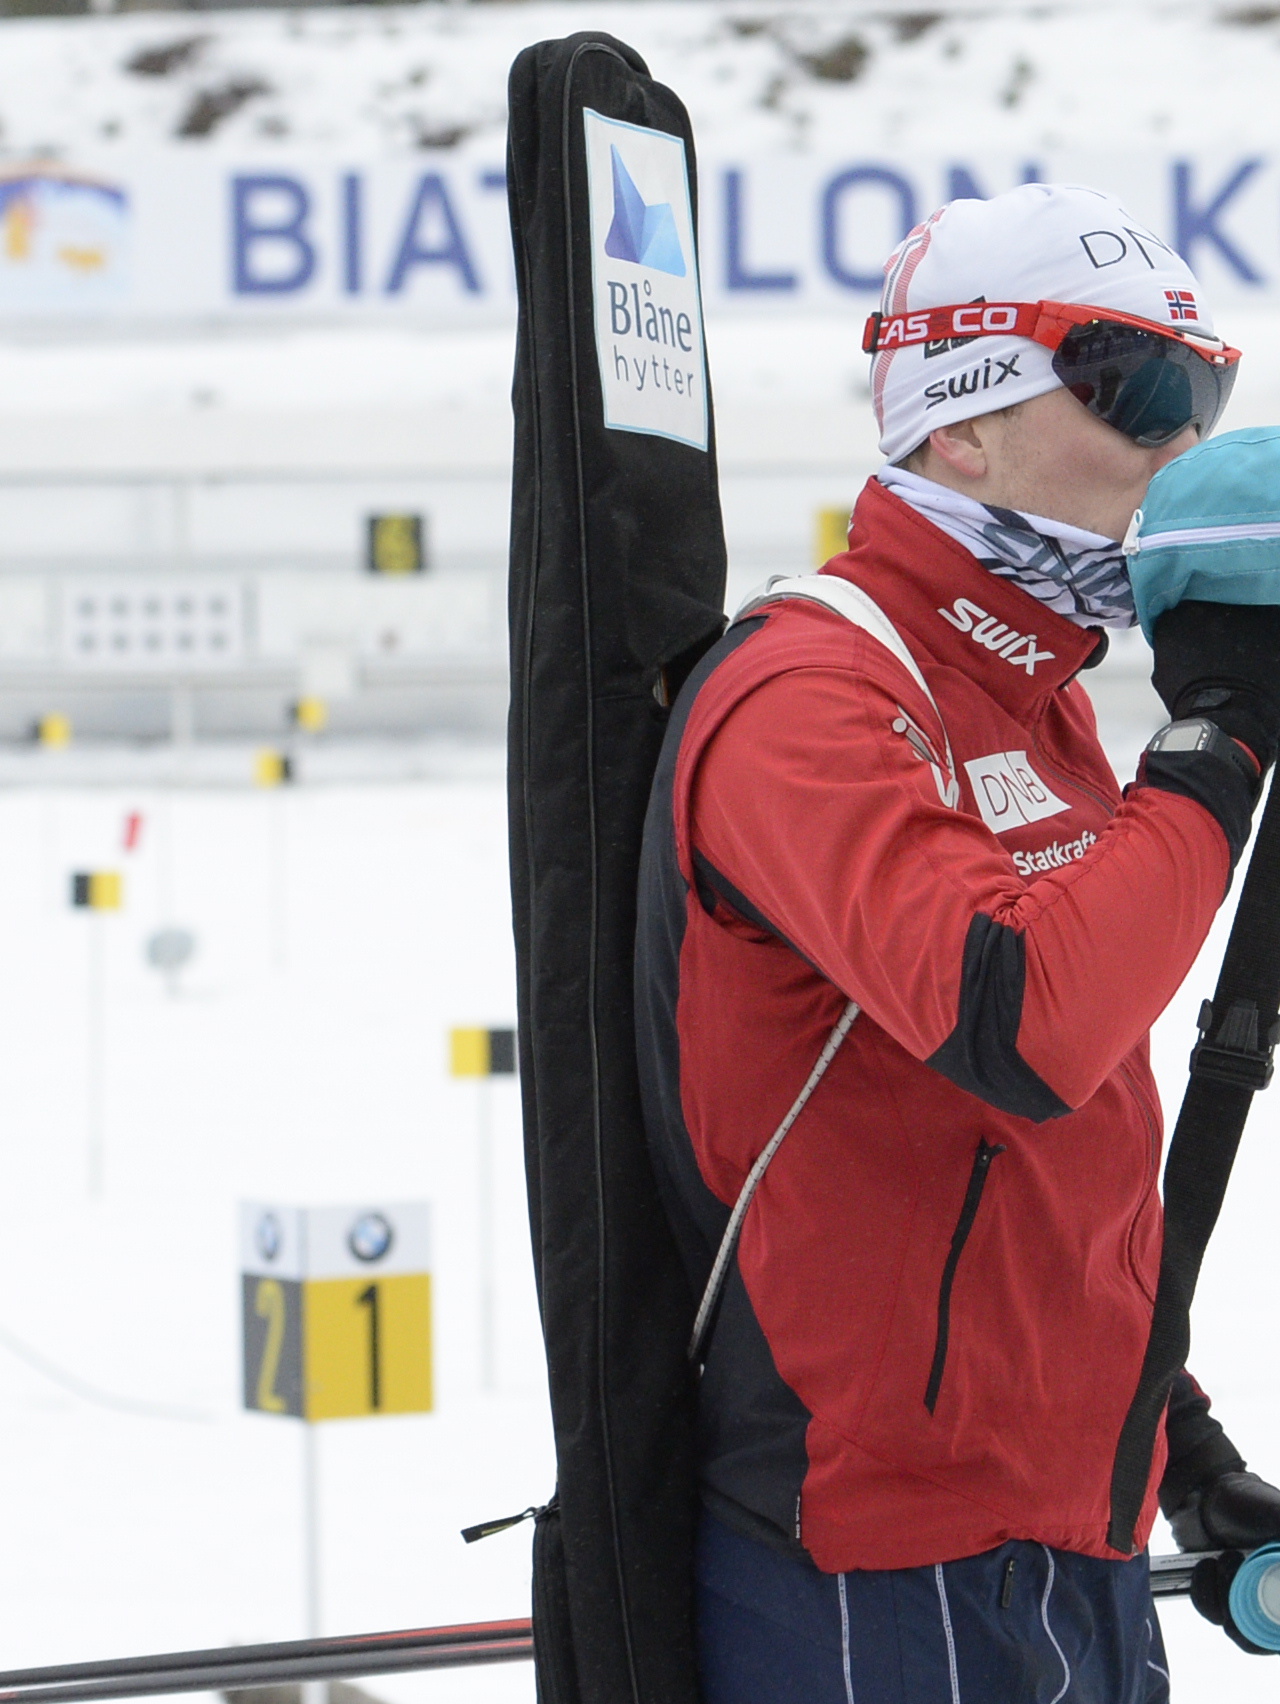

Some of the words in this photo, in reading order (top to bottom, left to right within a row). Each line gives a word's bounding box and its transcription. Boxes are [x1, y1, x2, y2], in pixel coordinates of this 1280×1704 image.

[607, 279, 692, 352] Blåne
[613, 344, 694, 398] hytter
[980, 766, 1047, 817] DNB
[1011, 830, 1097, 877] Statkraft
[255, 1277, 287, 1413] 2
[355, 1281, 383, 1413] 1
